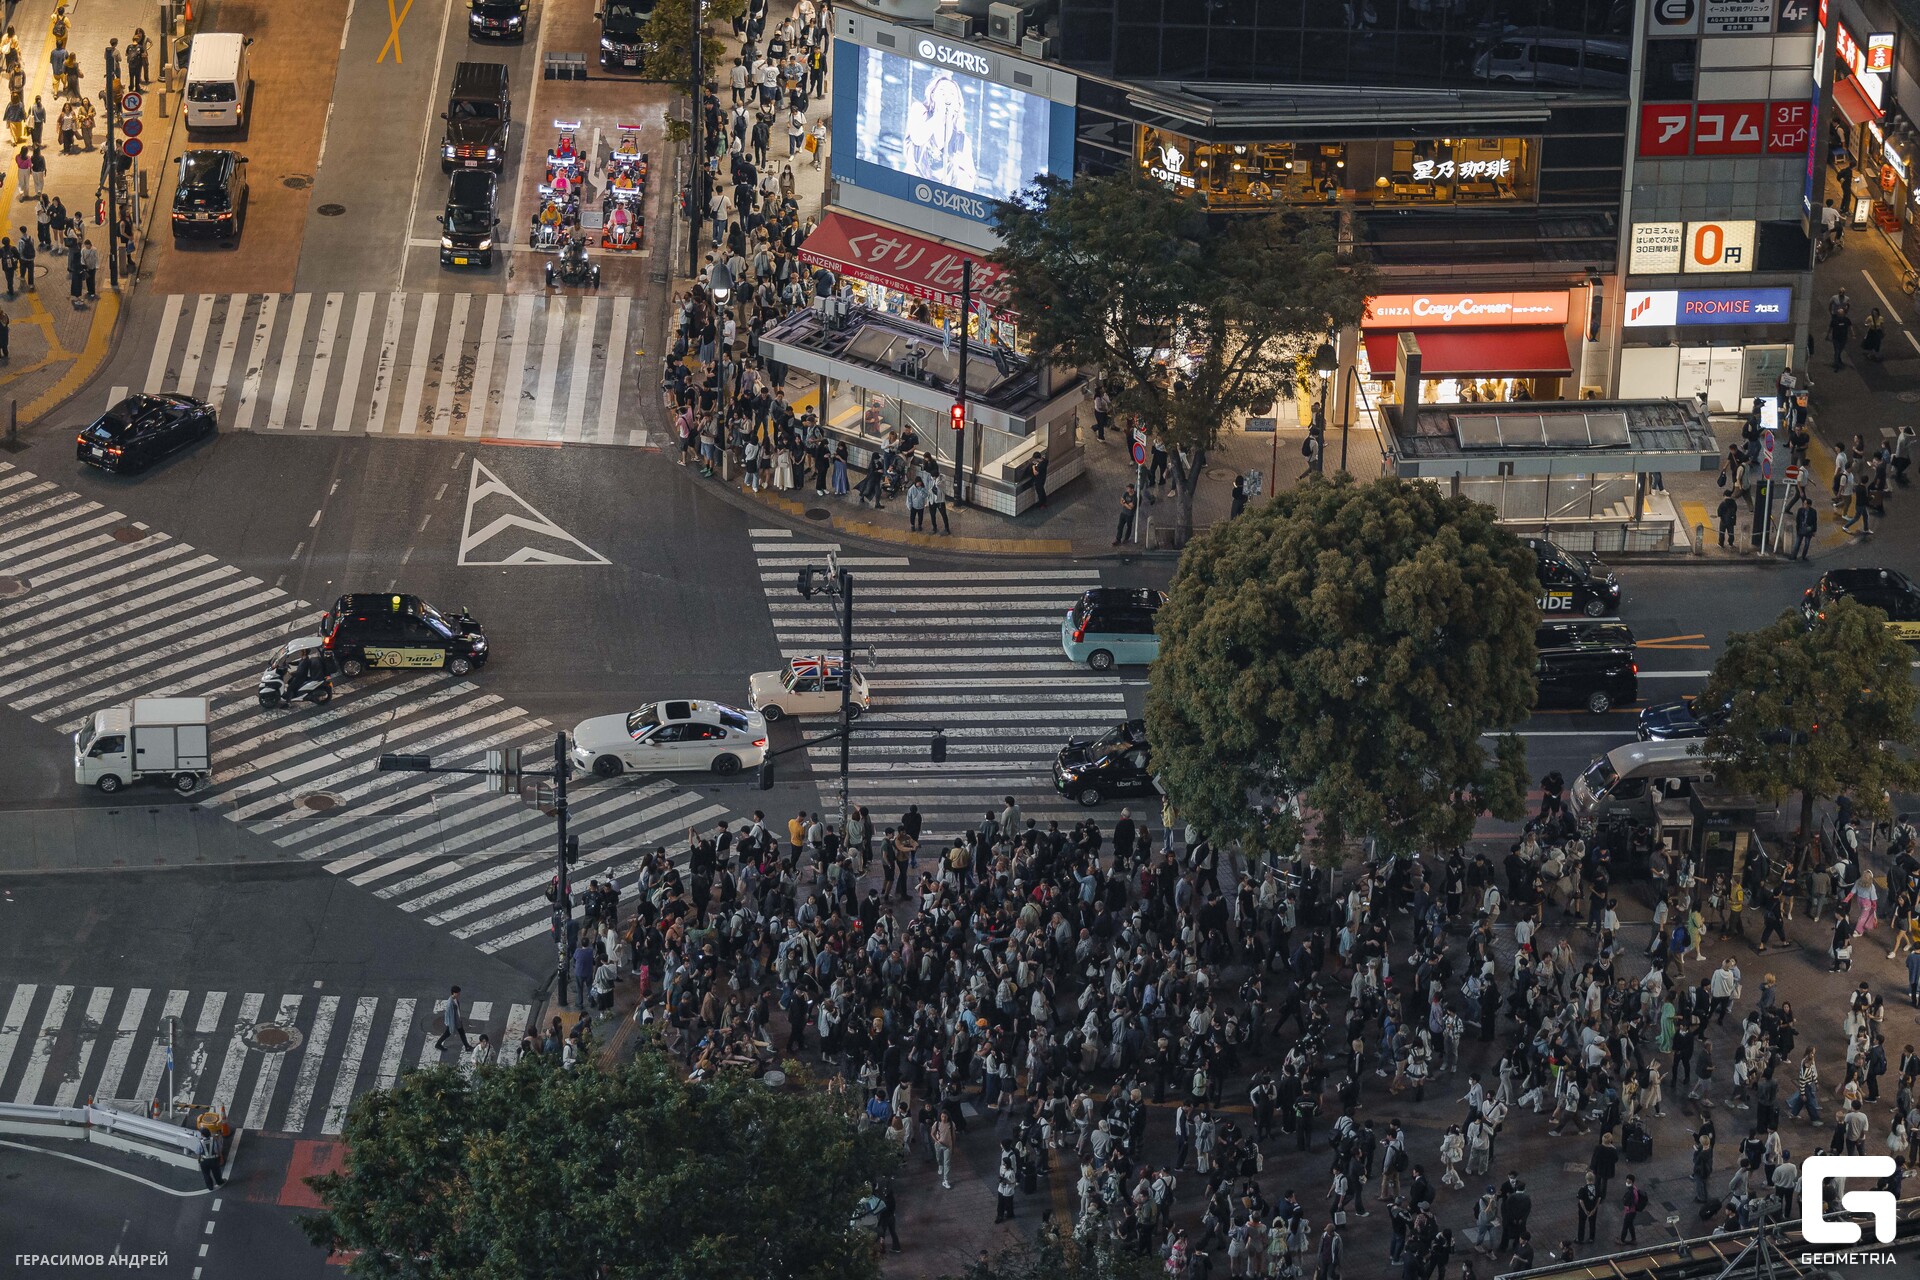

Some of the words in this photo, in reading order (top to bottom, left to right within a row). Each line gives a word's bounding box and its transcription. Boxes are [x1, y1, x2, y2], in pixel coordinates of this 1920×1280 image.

[1782, 0, 1808, 20] 4F
[937, 45, 990, 75] STARTS
[1778, 106, 1804, 123] 3F
[1658, 114, 1760, 144] アコム
[1769, 133, 1795, 147] 入口
[1150, 167, 1196, 189] COFFEE
[1412, 157, 1511, 181] 星乃珈琲
[933, 188, 986, 219] STARTS
[1636, 236, 1680, 244] はじめての方は
[1637, 227, 1680, 235] プロミスなら
[848, 232, 926, 271] くすり
[1636, 245, 1679, 253] 30日間利息
[1694, 224, 1742, 266] 0円
[802, 253, 843, 273] SANZENRI
[1377, 307, 1411, 316] GINZA
[1413, 298, 1456, 321] Cozy
[1458, 298, 1513, 316] Corner
[1685, 300, 1751, 315] PROMISE
[1754, 304, 1780, 313] プロミス
